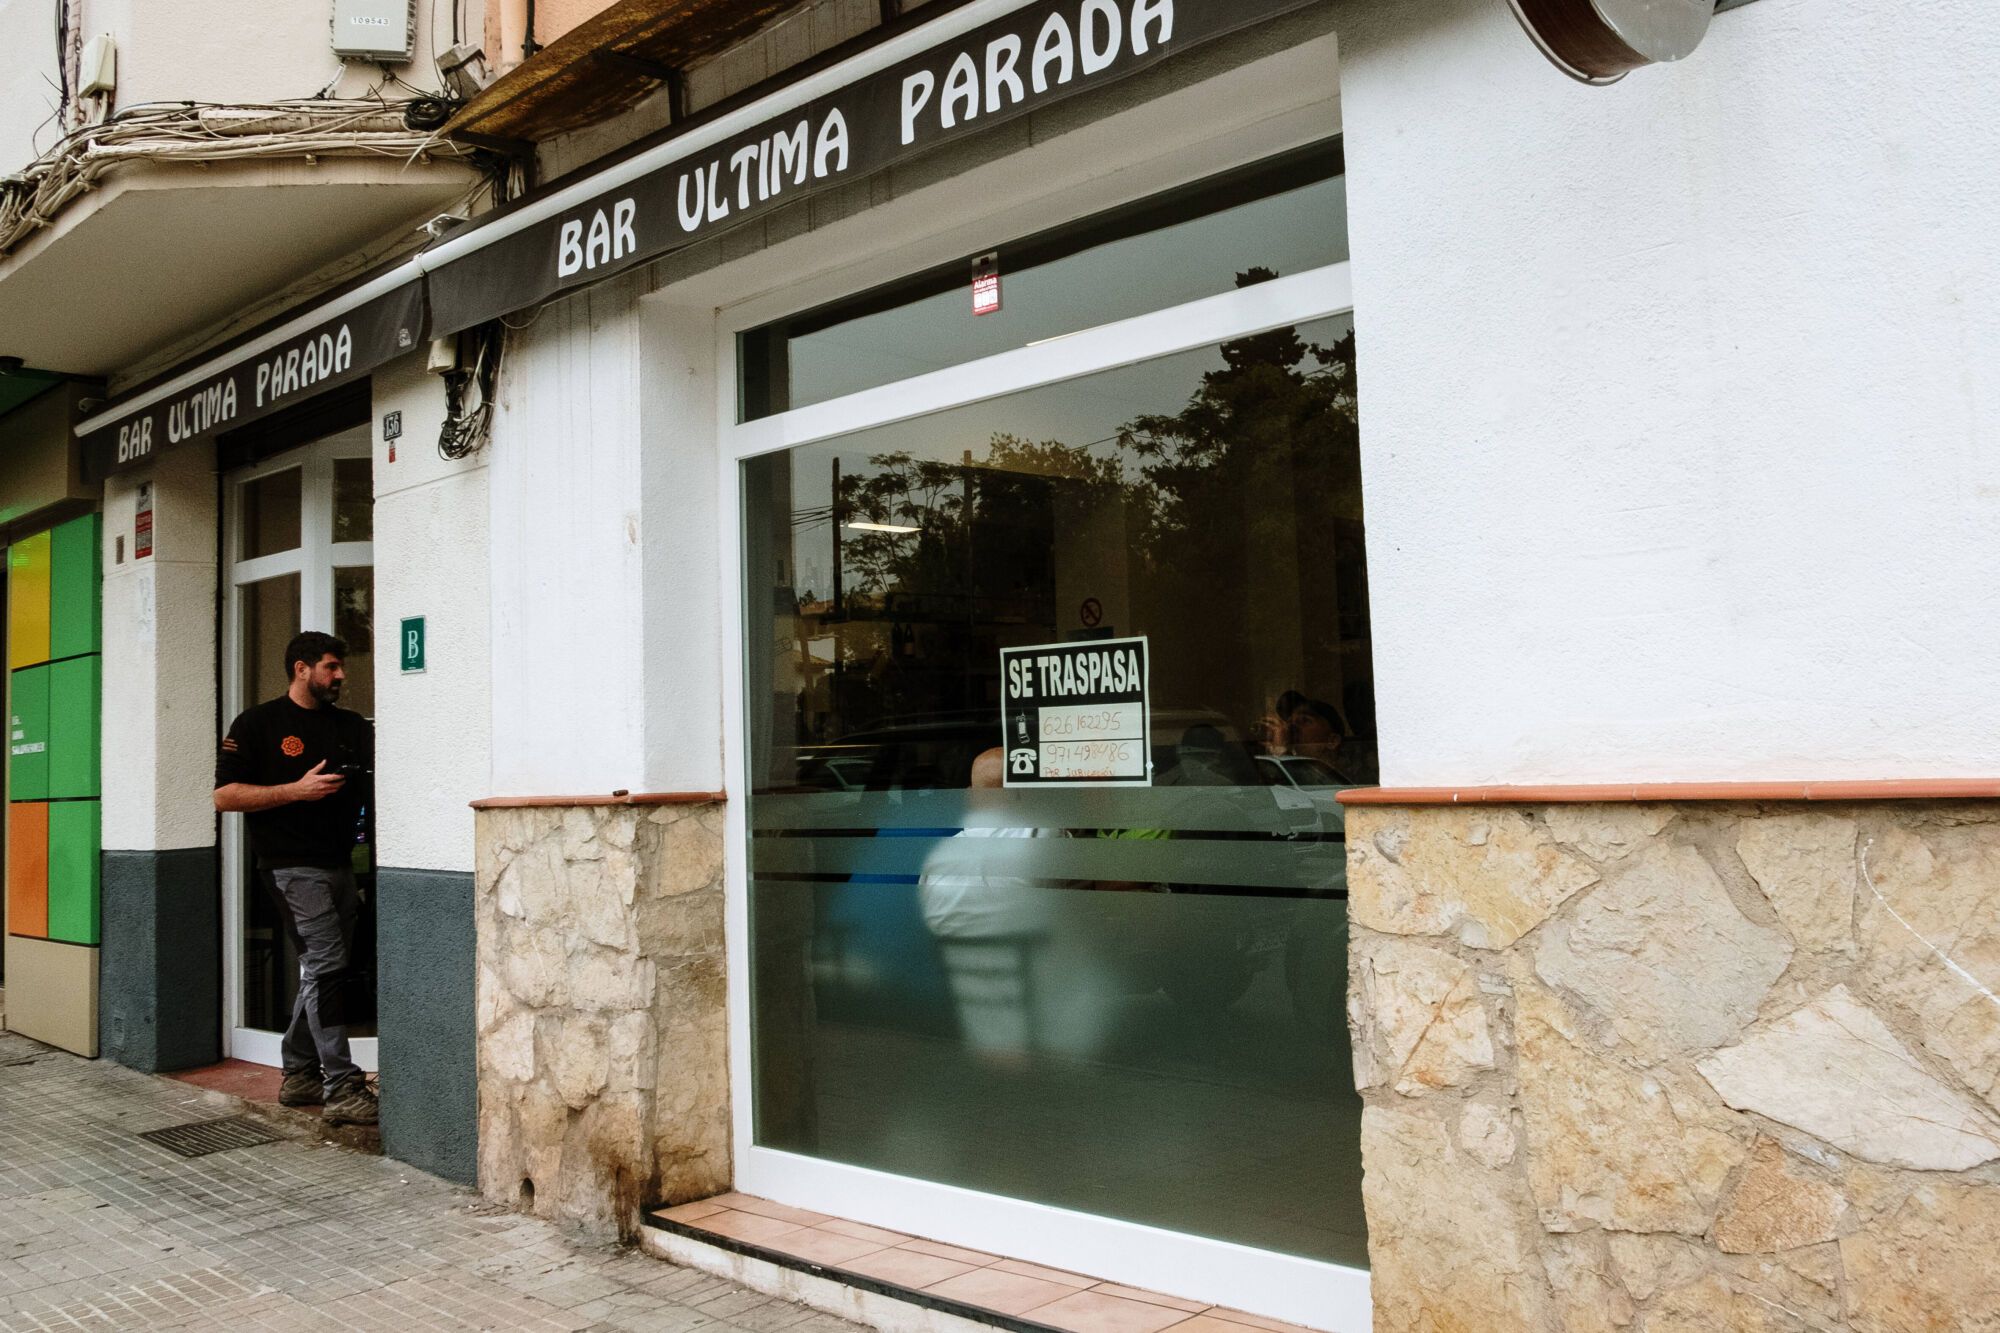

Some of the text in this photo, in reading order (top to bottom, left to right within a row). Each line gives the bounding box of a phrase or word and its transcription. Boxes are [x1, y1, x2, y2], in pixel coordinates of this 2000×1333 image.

[352, 17, 389, 25] 109543
[558, 0, 1174, 278] BAR ULTIMA PARADA
[118, 324, 352, 463] BAR ULTIMA PARADA
[407, 630, 419, 659] B
[1009, 649, 1142, 699] SE TRASPASA
